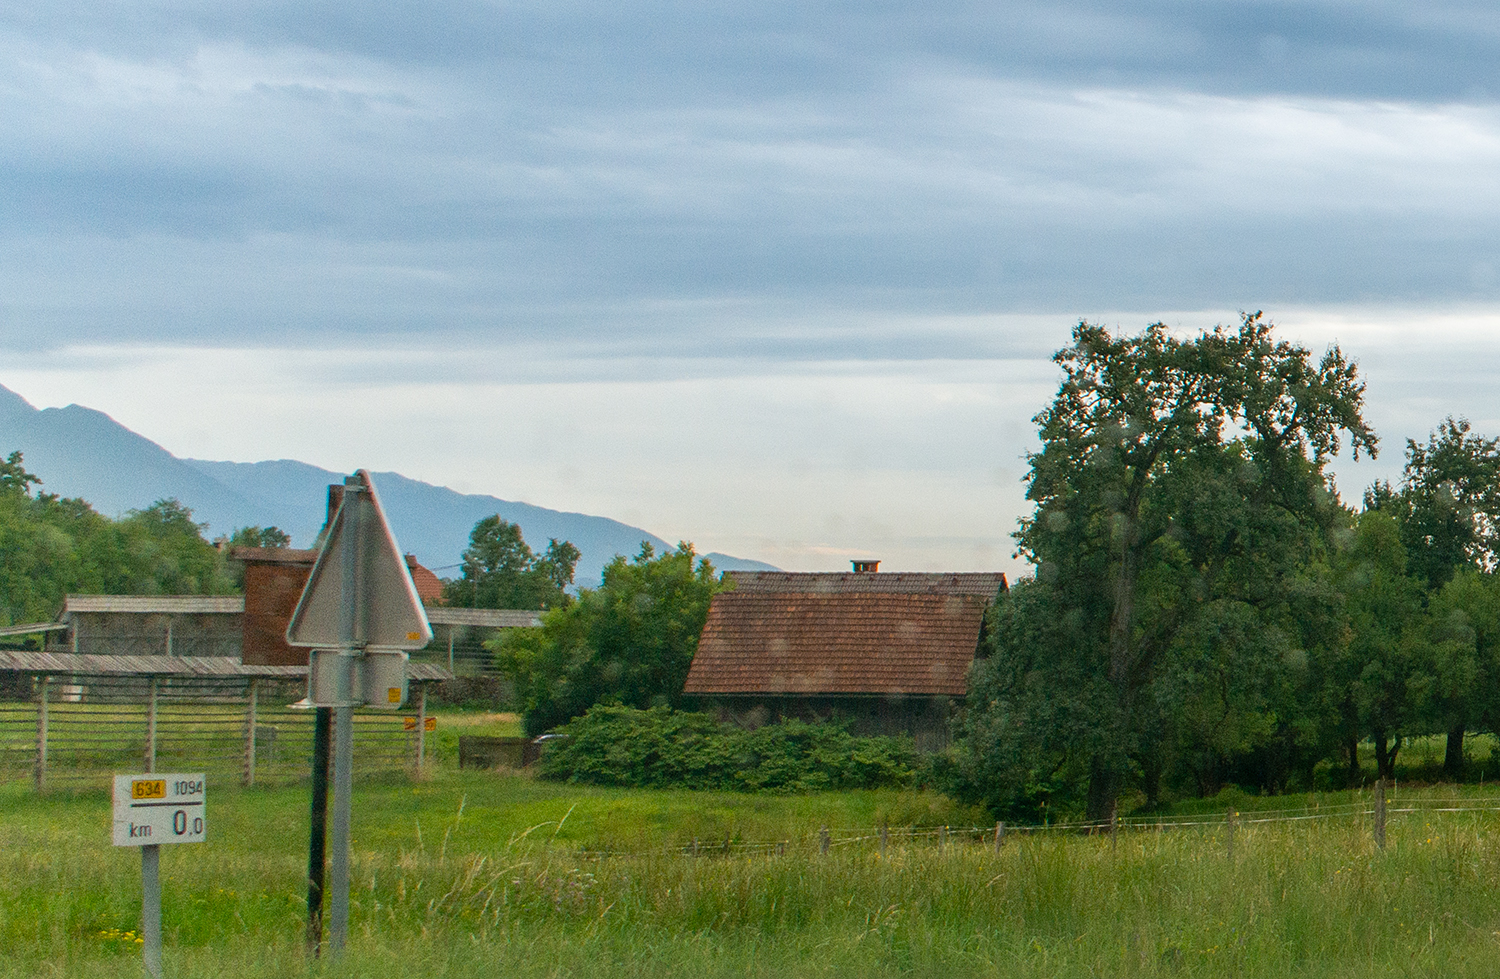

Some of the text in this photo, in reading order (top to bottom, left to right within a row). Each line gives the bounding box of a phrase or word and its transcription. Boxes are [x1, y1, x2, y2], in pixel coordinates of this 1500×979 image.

[135, 780, 203, 796] 634 1094
[129, 822, 153, 838] km
